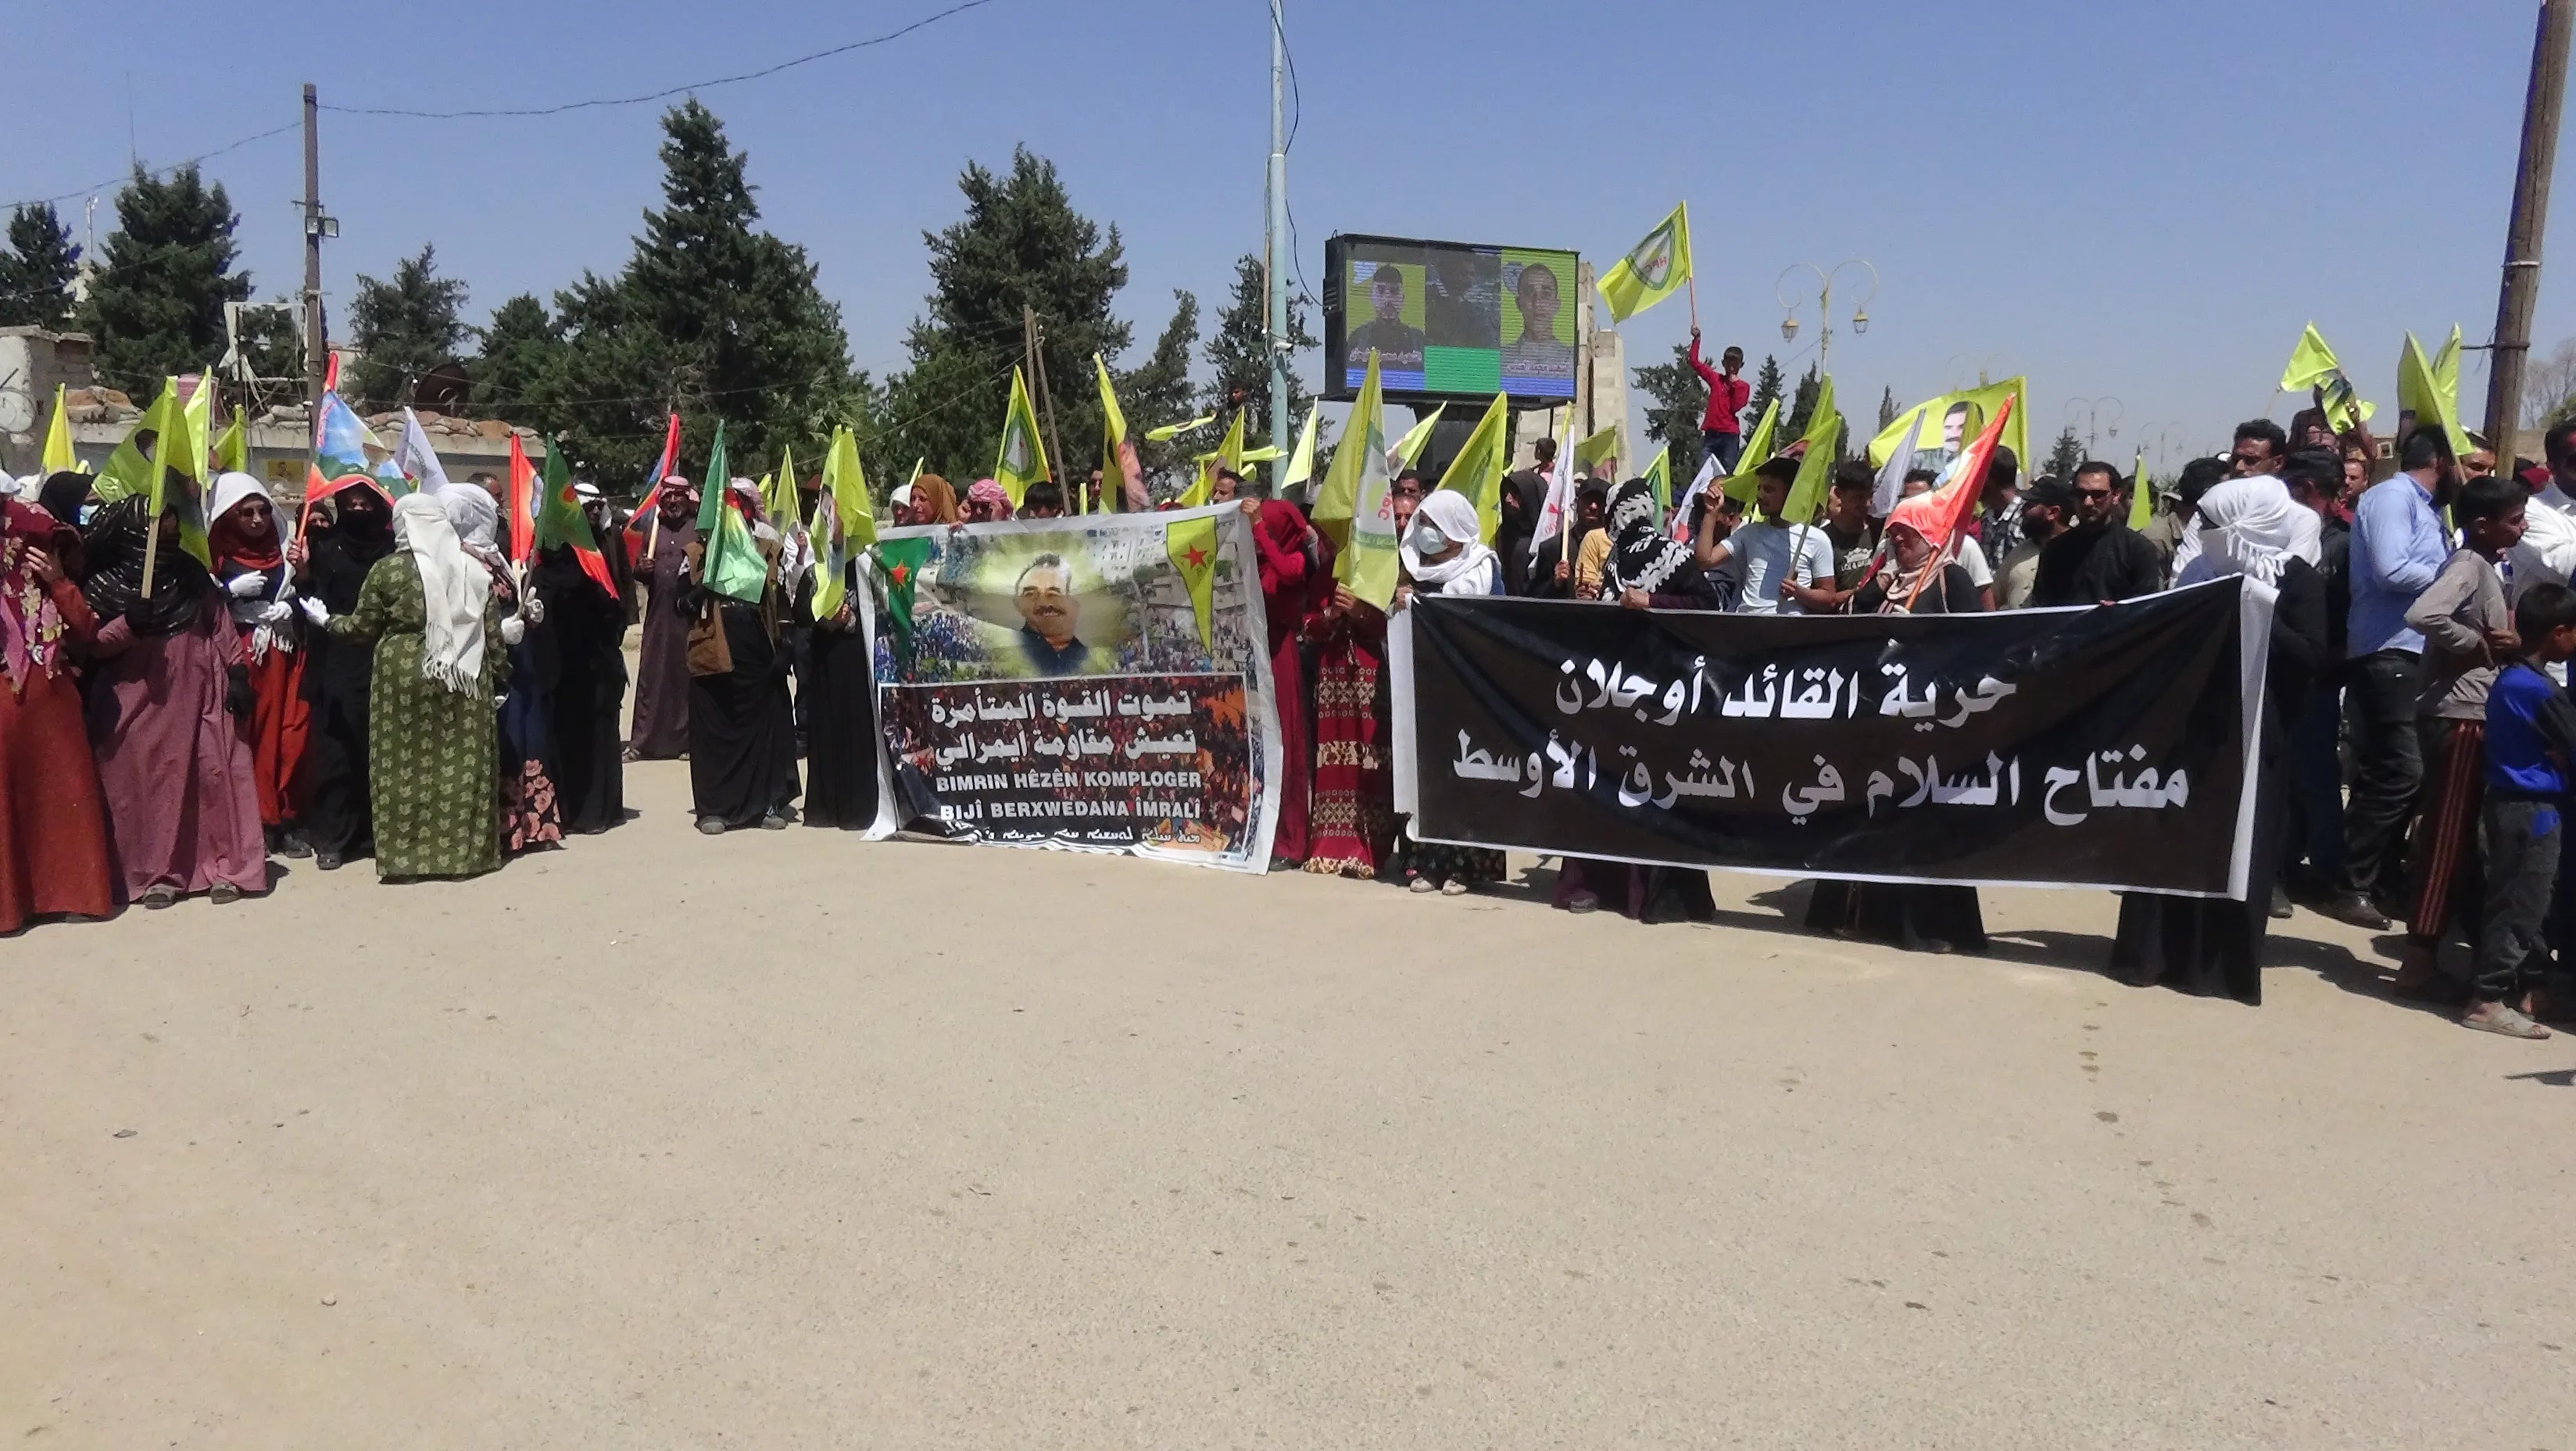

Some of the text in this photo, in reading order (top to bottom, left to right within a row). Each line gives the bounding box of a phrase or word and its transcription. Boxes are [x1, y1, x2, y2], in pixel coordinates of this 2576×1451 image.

[1042, 688, 1111, 724] القوة
[1118, 689, 1192, 722] تموت
[1555, 654, 2016, 732] حرية القائد أوجلان
[1033, 727, 1114, 761] مقاومة
[1125, 727, 1197, 760] تعيش
[936, 768, 1202, 792] BIMRIN HÊZÊN KOMPLOGER
[1453, 729, 2189, 826] مفتاح السلام في الشرق الأوسط
[940, 796, 1200, 820] BIJÎ BERXWEDANA ÎMRALÎ
